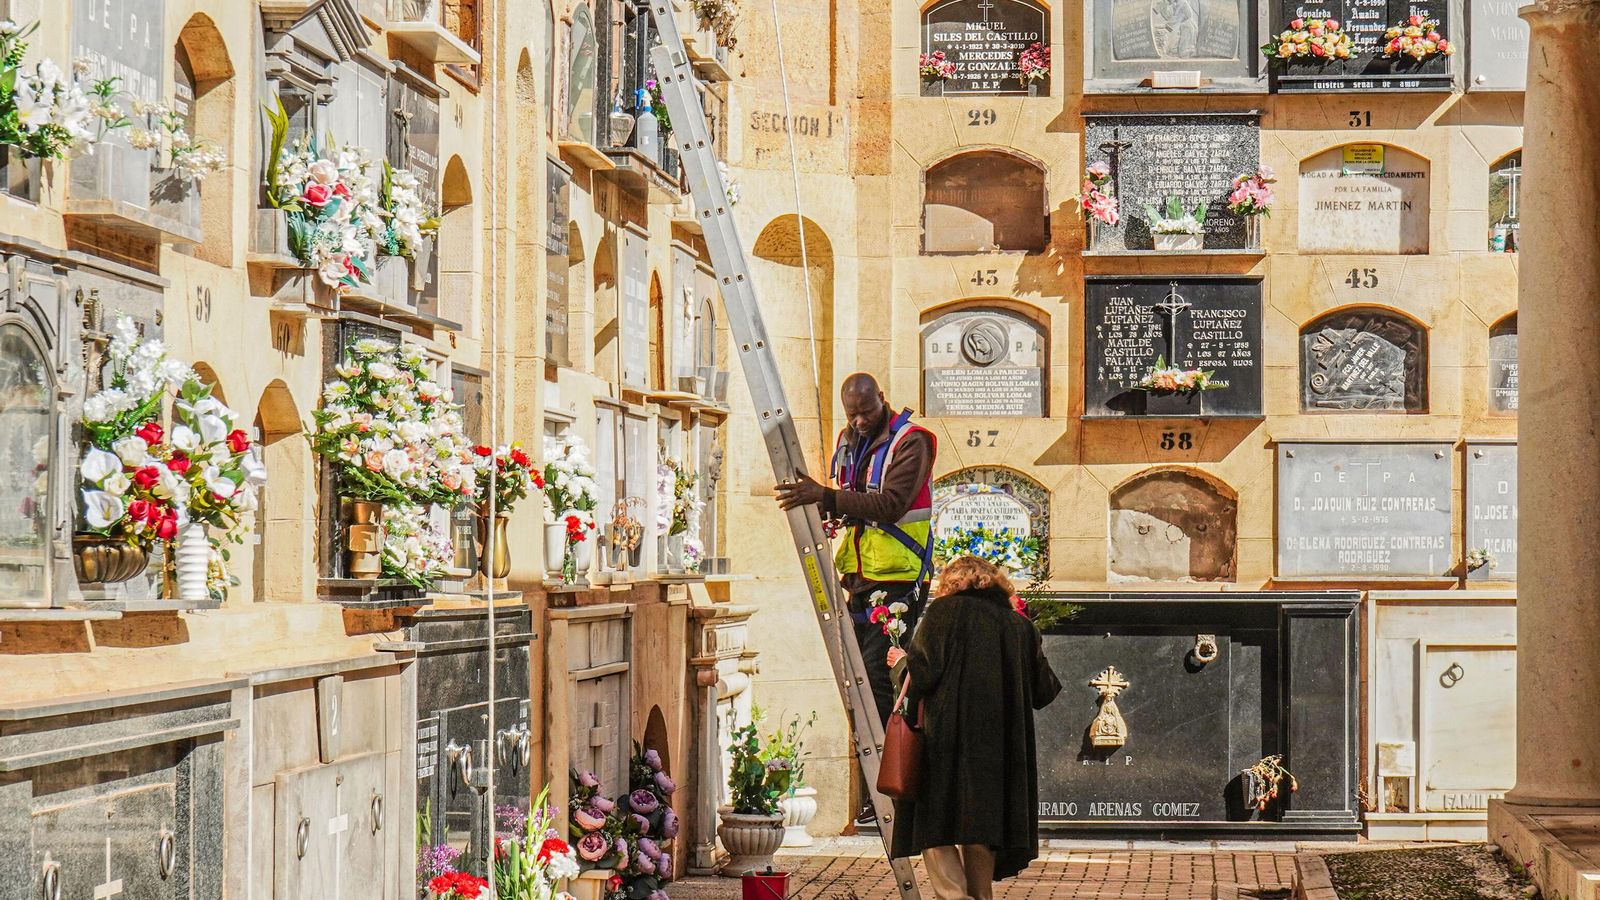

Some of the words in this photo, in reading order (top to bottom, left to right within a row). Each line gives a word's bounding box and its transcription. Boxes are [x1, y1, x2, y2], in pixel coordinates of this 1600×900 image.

[1351, 7, 1380, 19] Amalia
[965, 21, 1007, 31] MIGUEL
[933, 32, 962, 42] SILES
[965, 32, 984, 42] DEL
[986, 31, 1038, 41] CASTILLO
[1354, 32, 1378, 46] Lopez
[958, 51, 1014, 61] MERCEDES
[967, 108, 997, 127] 29
[1348, 110, 1371, 127] 31
[1314, 200, 1362, 211] JIMENEZ
[1367, 200, 1413, 211] MARTIN
[1344, 267, 1379, 289] 45
[196, 285, 211, 324] 59
[1109, 297, 1134, 306] JUAN
[1105, 305, 1154, 315] LUPIAÑEZ
[1189, 309, 1247, 319] FRANCISCO
[1192, 318, 1243, 329] LUPIAÑEZ
[1192, 330, 1243, 340] CASTILLO
[1015, 341, 1024, 353] P.
[1107, 338, 1153, 348] MATILDE
[1103, 347, 1155, 357] CASTILLO
[1231, 349, 1252, 358] AÑOS
[1105, 357, 1143, 366] PALMA
[966, 430, 1000, 447] 57
[1160, 432, 1193, 451] 58
[1313, 471, 1322, 483] D
[1338, 471, 1347, 483] E
[1383, 471, 1391, 483] P
[1408, 471, 1416, 483] A
[1293, 496, 1305, 511] D.
[1310, 496, 1352, 512] JOAQUIN
[1355, 496, 1378, 511] RUIZ
[1381, 496, 1437, 511] CONTRERAS
[1299, 537, 1332, 550] ELENA
[1334, 536, 1445, 550] RODRIGUEZ-CONTRERAS
[1337, 550, 1392, 564] RODRIGUEZ
[331, 694, 339, 737] 2
[1125, 755, 1134, 766] P.
[1443, 792, 1501, 811] FAMIL
[1088, 801, 1142, 817] ARENAS
[1152, 801, 1201, 817] GOMEZ
